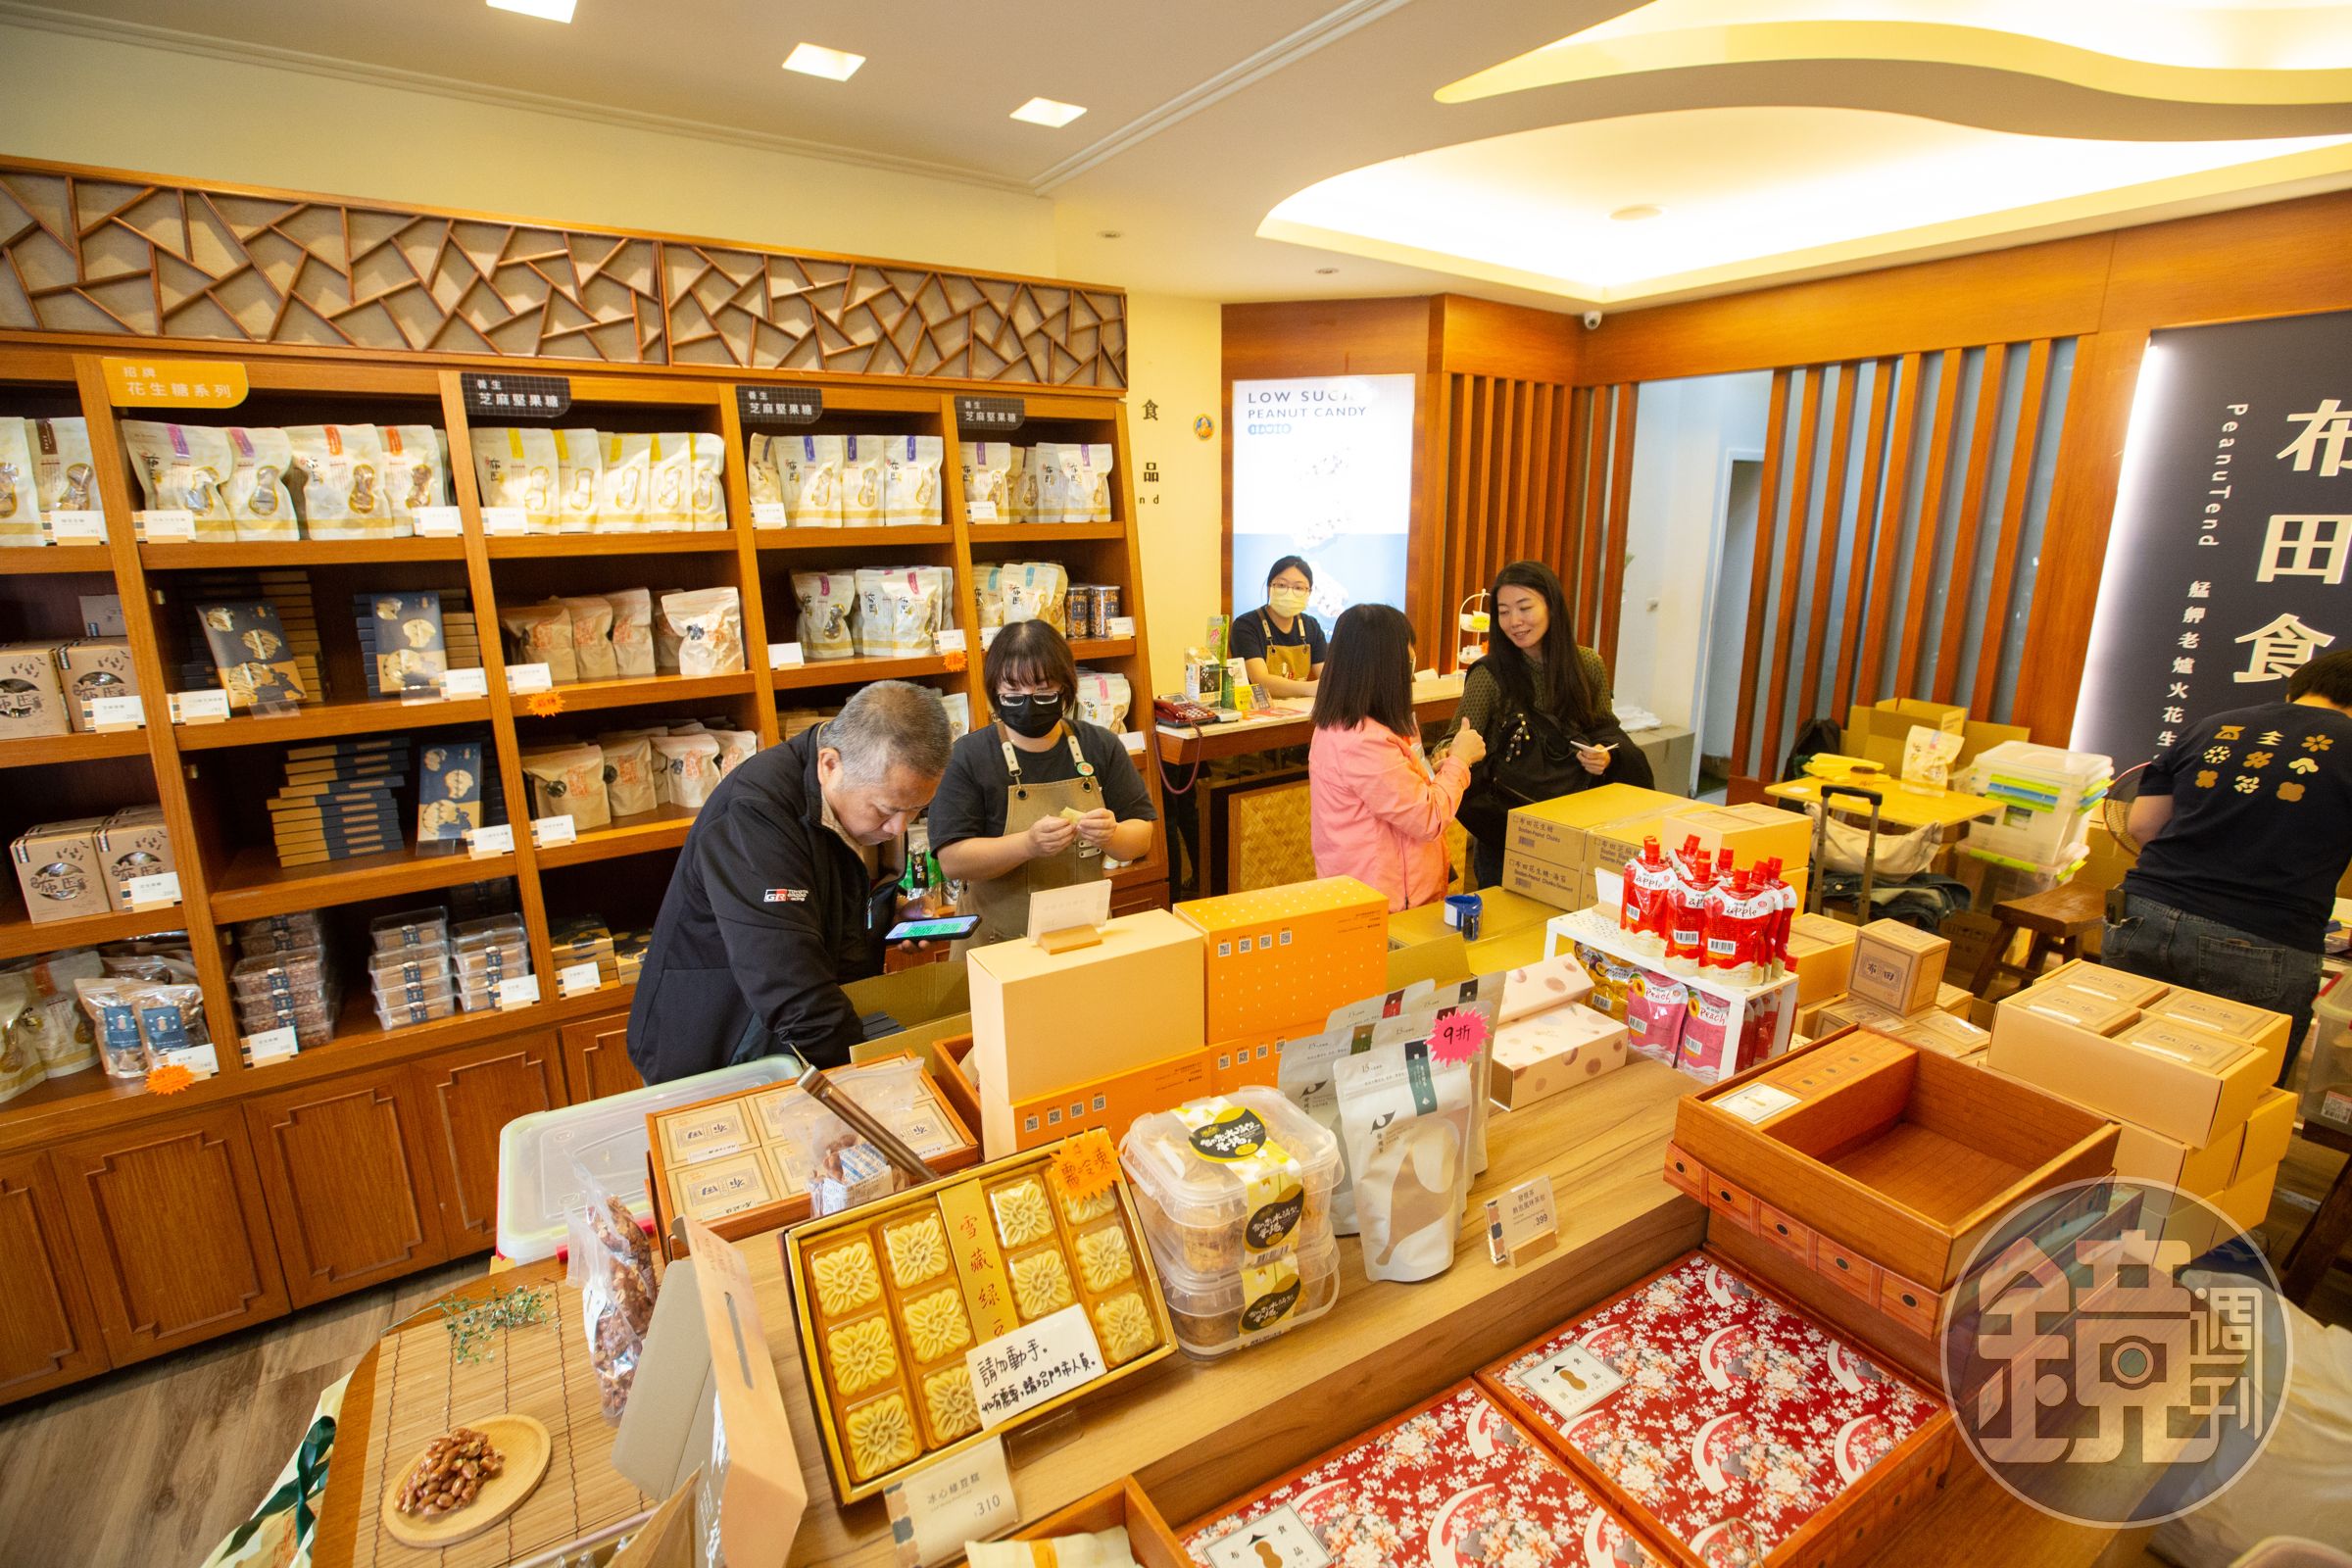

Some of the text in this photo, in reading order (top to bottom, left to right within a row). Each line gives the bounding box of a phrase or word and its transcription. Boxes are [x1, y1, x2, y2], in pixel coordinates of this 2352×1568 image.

[127, 381, 232, 399] 花生糖系列
[1248, 390, 1291, 404] LOW
[478, 392, 559, 408] 芝麻堅果糖
[1248, 405, 1367, 419] PEANUT CANDY
[2197, 402, 2249, 547] PeanuTend
[2153, 580, 2211, 760] 艋舺老爐火花生
[1726, 904, 1757, 917] apple
[1700, 1006, 1726, 1025] Peach
